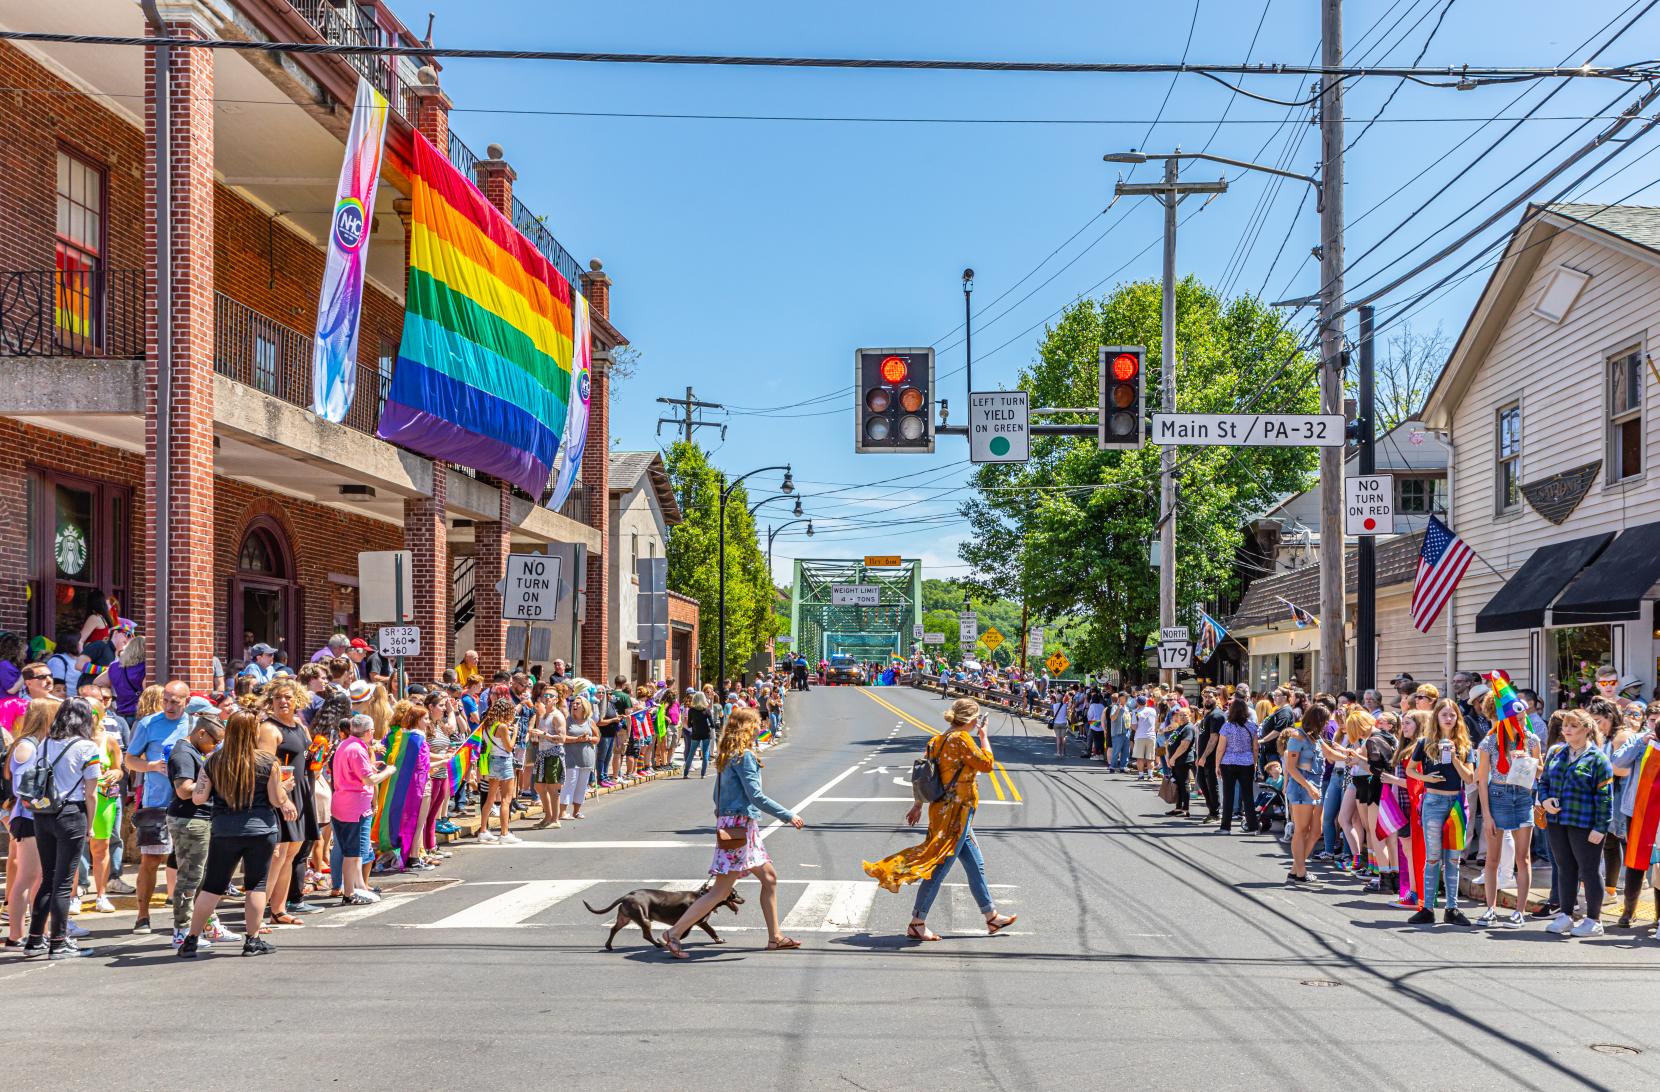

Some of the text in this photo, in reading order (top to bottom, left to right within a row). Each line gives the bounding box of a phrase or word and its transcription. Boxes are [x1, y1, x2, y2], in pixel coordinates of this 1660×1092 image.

[340, 212, 361, 235] NHC
[972, 397, 1025, 407] LEFT TURN
[983, 409, 1015, 421] YIELD
[975, 423, 1024, 433] ON GREEN
[1161, 420, 1208, 438] Main
[1217, 420, 1237, 439] St
[1264, 421, 1327, 440] PA-32
[1358, 480, 1379, 491] NO
[1355, 494, 1384, 504] TURN
[1349, 505, 1390, 516] ON RED
[523, 561, 545, 576] NO
[516, 577, 550, 590] TURN
[522, 591, 539, 603] ON
[517, 604, 542, 616] RED
[385, 628, 413, 636] SR 32
[1162, 630, 1187, 639] NORTH
[390, 637, 407, 646] 360
[390, 646, 407, 655] 360
[1162, 647, 1188, 663] 179
